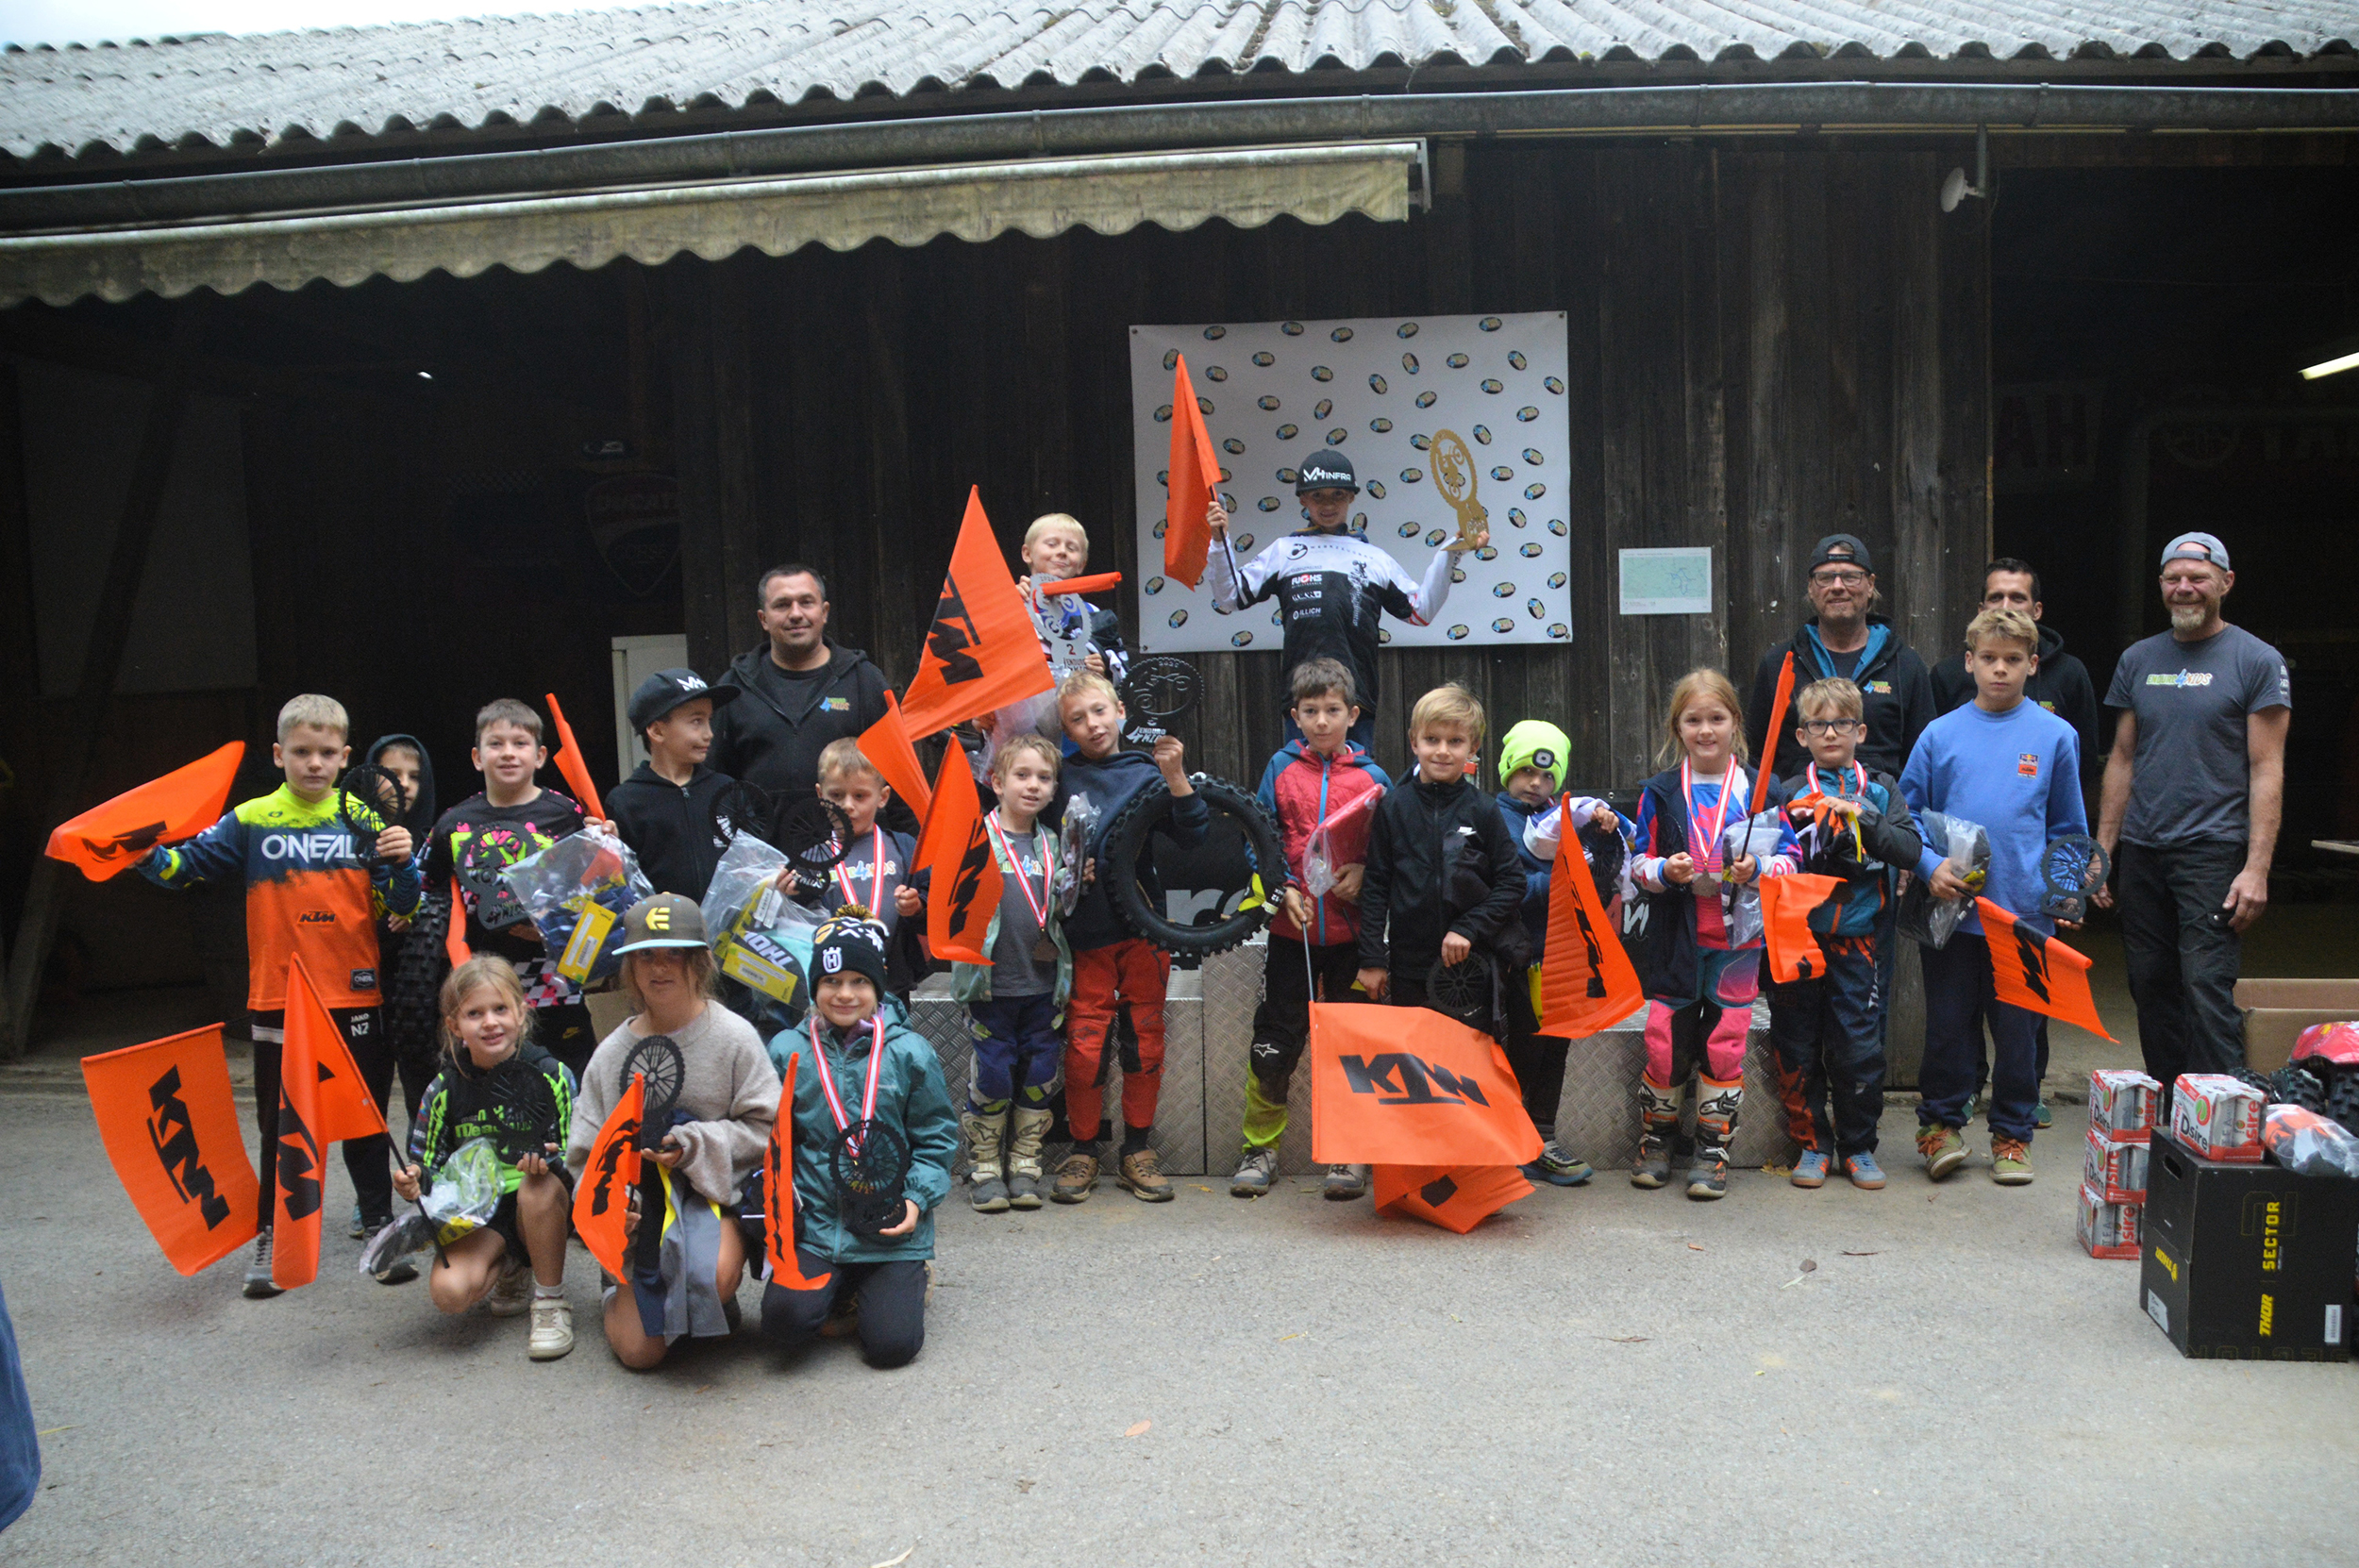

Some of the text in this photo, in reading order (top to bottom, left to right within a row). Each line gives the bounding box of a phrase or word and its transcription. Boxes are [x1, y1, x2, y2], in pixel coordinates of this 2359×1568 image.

[1292, 574, 1322, 585] FUCHS
[1066, 643, 1076, 656] 2
[299, 910, 336, 923] KTM
[350, 1012, 370, 1024] JAKO
[1338, 1053, 1492, 1109] KTM
[2181, 1112, 2209, 1151] Dsire
[146, 1062, 231, 1232] KTM
[2258, 1201, 2281, 1338] THOR SECTOR
